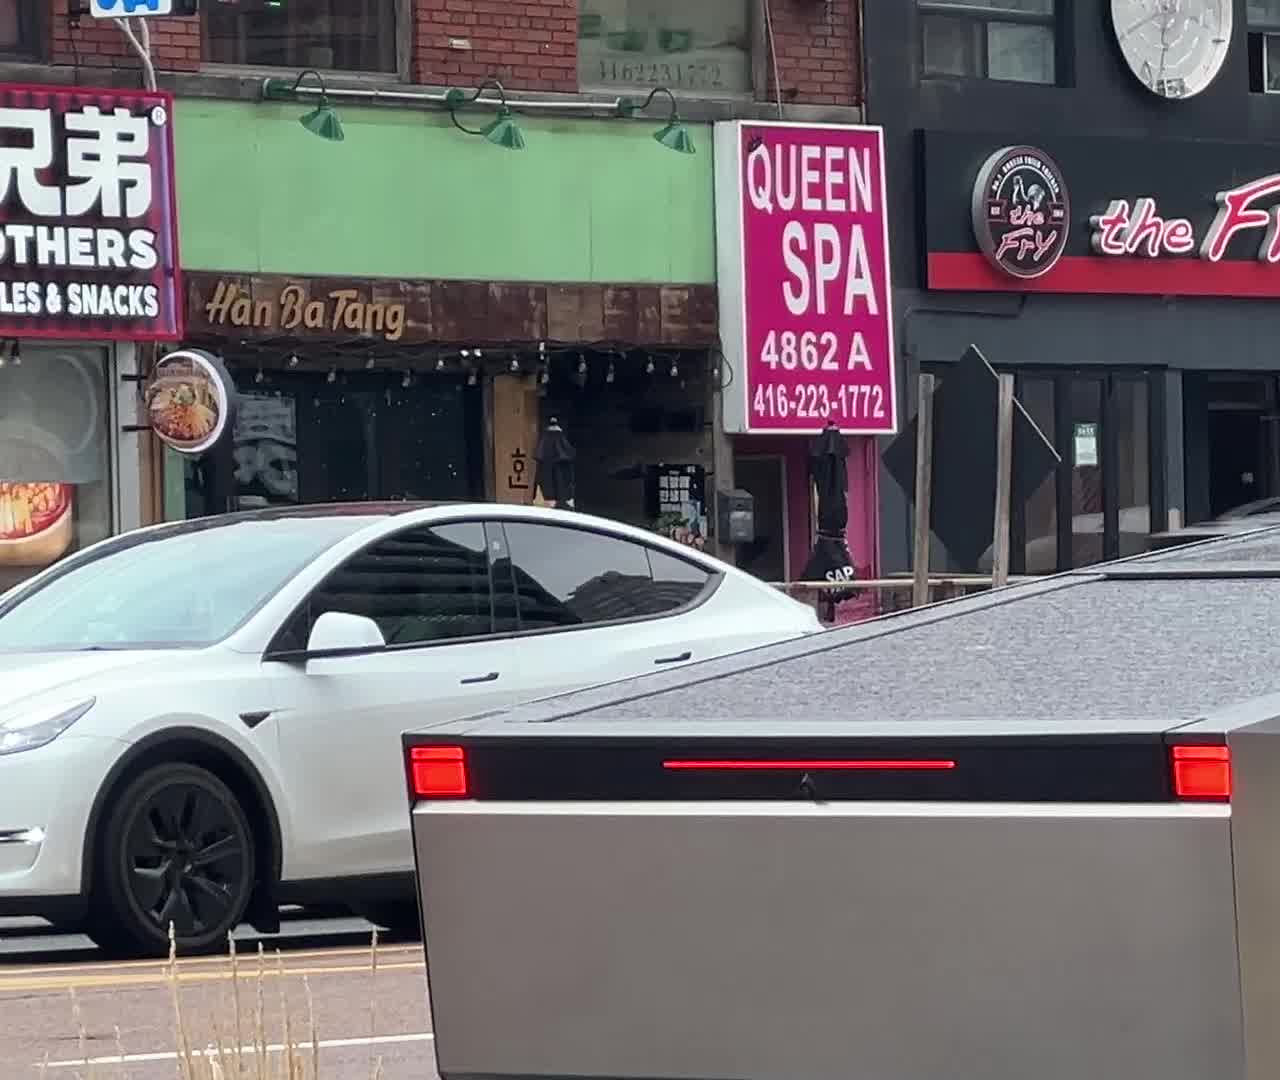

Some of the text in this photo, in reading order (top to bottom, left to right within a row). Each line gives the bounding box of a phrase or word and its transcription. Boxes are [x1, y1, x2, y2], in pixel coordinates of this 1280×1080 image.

[747, 143, 873, 214] QUEEN
[0, 224, 158, 270] THERS
[1096, 198, 1194, 257] the
[782, 220, 879, 315] SPA
[46, 283, 62, 315] &
[67, 283, 159, 318] SNACKS
[206, 281, 405, 341] Han Ba Tang
[760, 330, 873, 370] 4862 A
[753, 383, 885, 418] 416-223-1772
